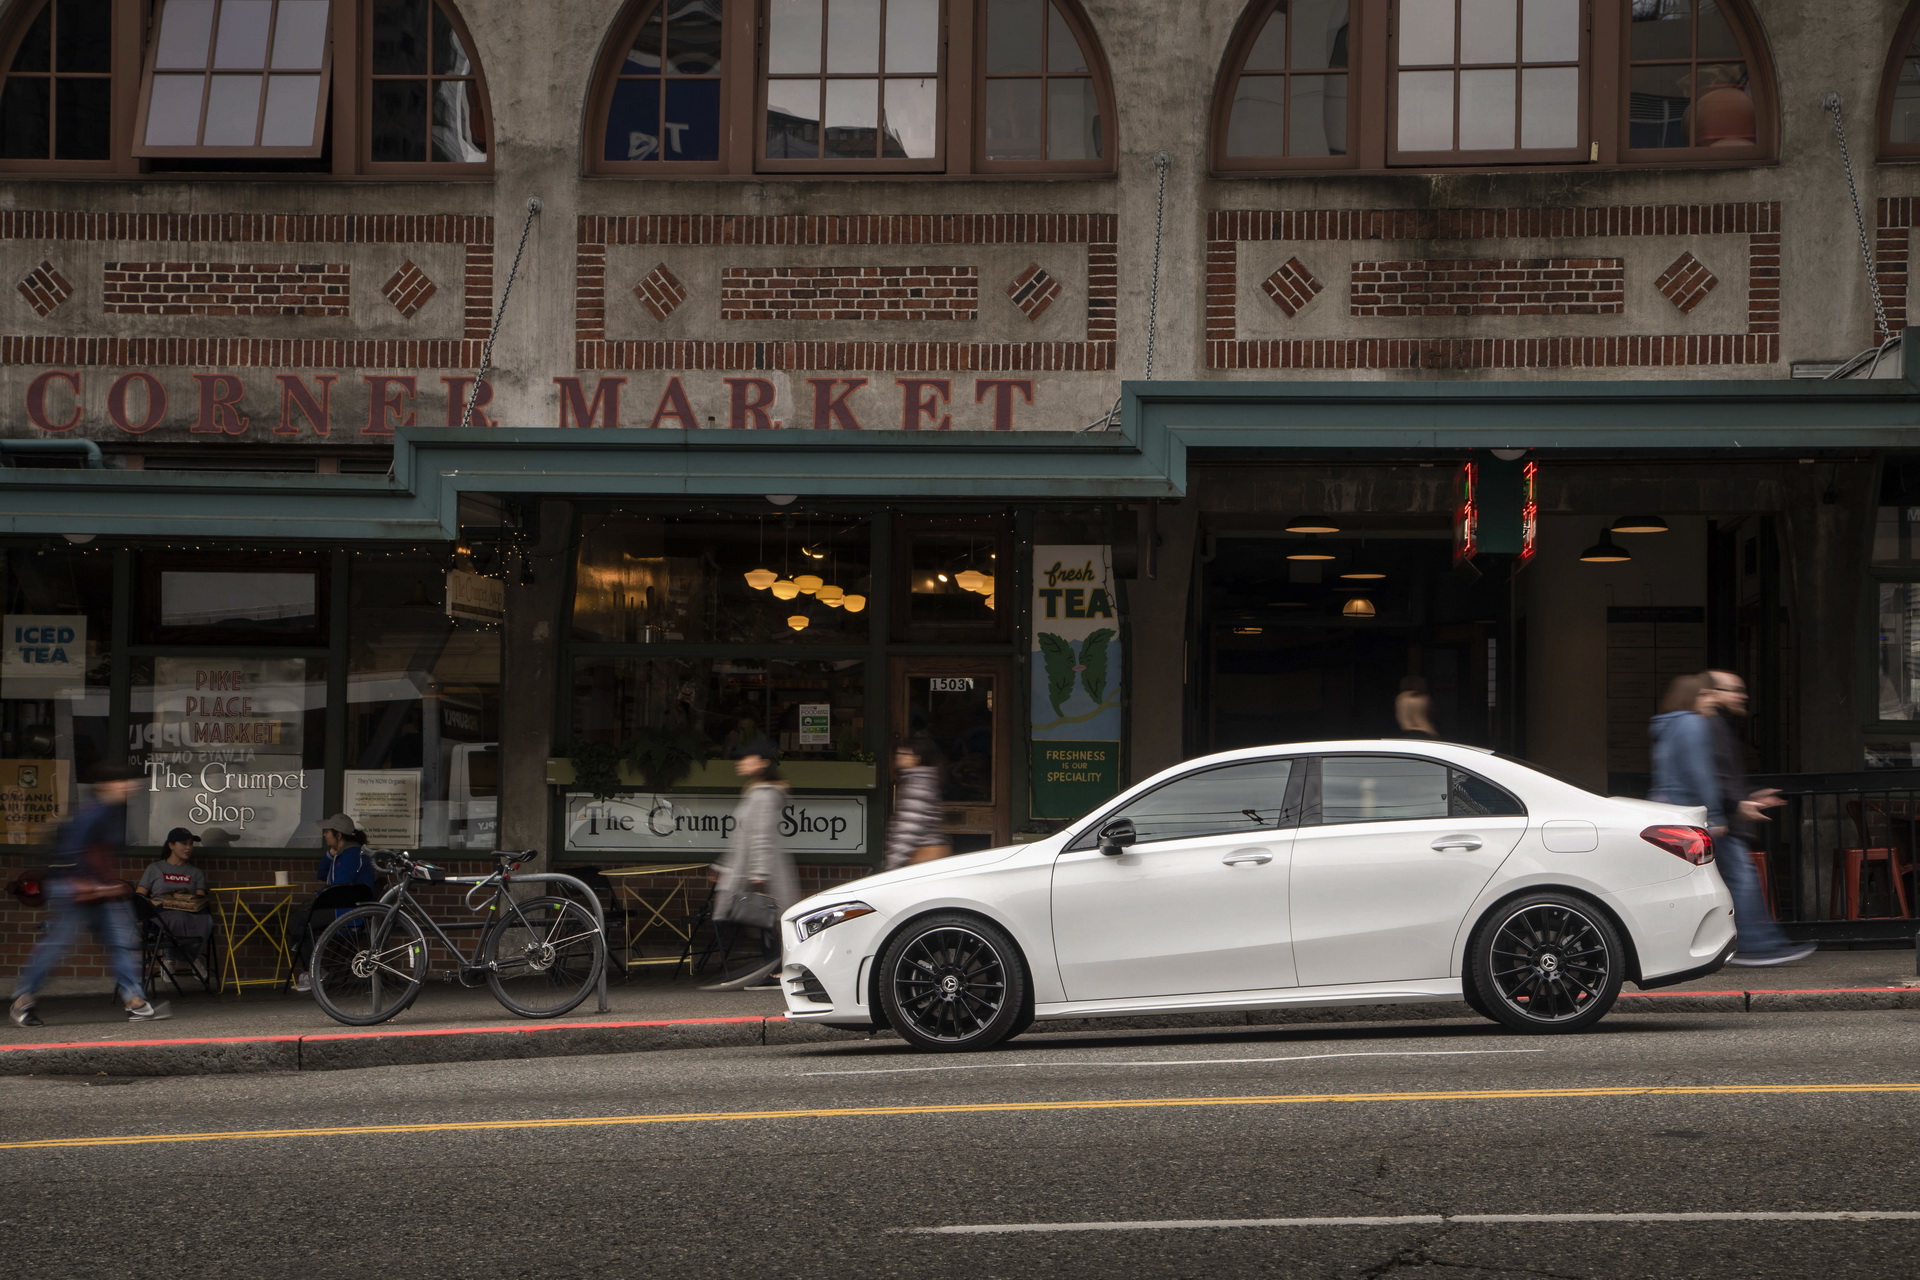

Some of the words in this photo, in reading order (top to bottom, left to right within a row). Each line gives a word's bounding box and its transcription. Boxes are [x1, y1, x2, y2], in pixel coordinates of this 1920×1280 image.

[26, 370, 498, 435] CORNER
[552, 376, 1035, 431] MARKET
[1043, 560, 1095, 587] fresh
[1038, 588, 1114, 620] TEA
[15, 626, 75, 644] ICED
[19, 647, 70, 664] TEA
[195, 670, 243, 691] PIKE
[932, 678, 965, 691] 1503
[185, 696, 253, 717] PLACE
[193, 722, 278, 744] MARKET
[1046, 749, 1106, 761] FRESHNESS
[1062, 762, 1069, 770] IS
[1072, 762, 1088, 770] OUR
[144, 760, 193, 792] The
[200, 762, 309, 797] Crumpet
[1047, 772, 1102, 783] SPECIALITY
[0, 793, 54, 802] ORGANIC
[23, 803, 60, 812] TRADE
[188, 793, 255, 830] Shop
[5, 814, 47, 823] COFFEE
[586, 805, 635, 836] The
[648, 805, 743, 839] Crump
[777, 804, 847, 841] Shop
